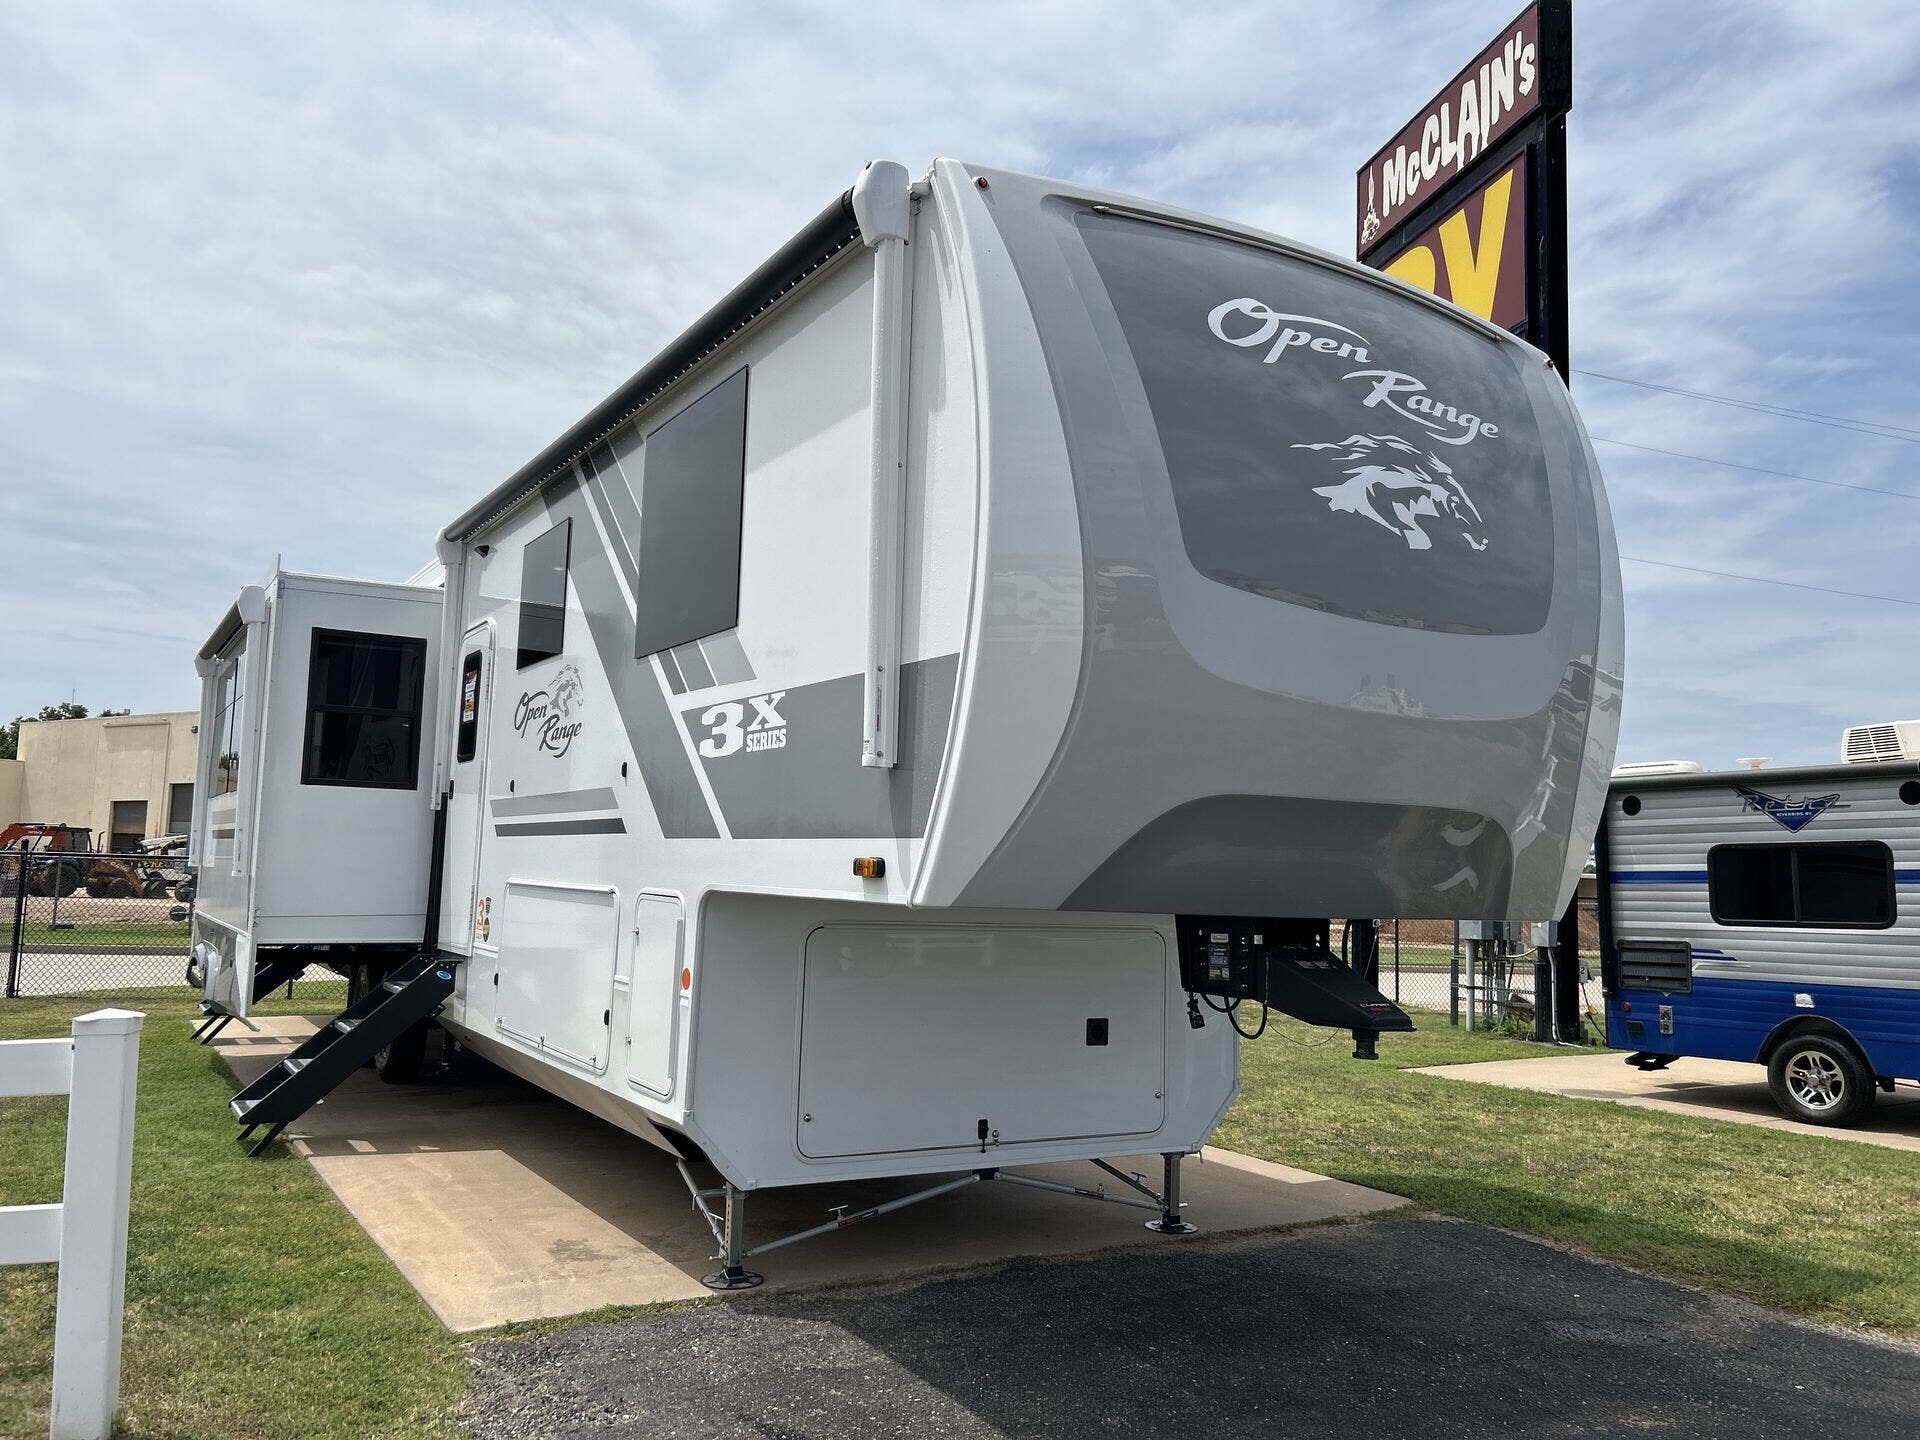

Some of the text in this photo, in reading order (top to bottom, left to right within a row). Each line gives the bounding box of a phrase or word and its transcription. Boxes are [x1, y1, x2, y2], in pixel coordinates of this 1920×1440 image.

[1382, 31, 1536, 218] McCLAIN's
[1207, 297, 1371, 363] Open
[1341, 369, 1499, 445] Range
[514, 690, 550, 738] Open
[537, 713, 583, 759] Range
[746, 729, 787, 752] SERIES
[1580, 966, 1585, 975] 2
